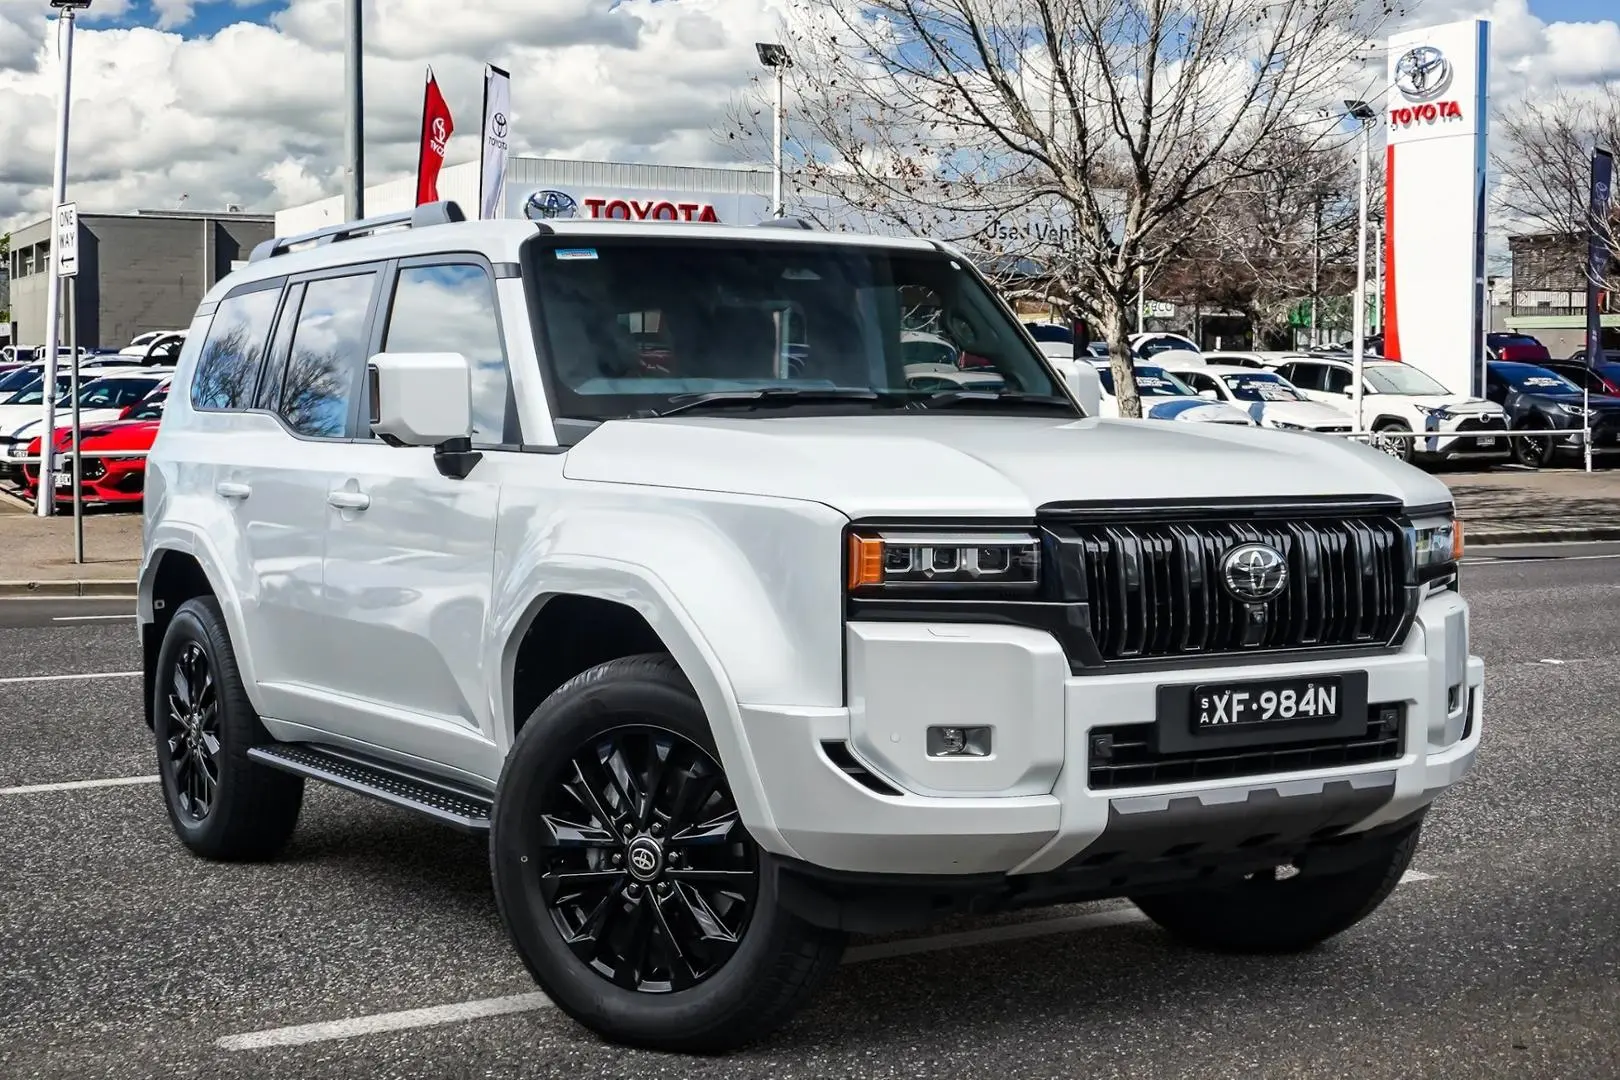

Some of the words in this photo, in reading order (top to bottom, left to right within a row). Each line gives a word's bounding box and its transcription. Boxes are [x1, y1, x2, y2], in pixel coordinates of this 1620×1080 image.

[1389, 101, 1462, 125] TOYOTA
[59, 209, 74, 228] ONE
[585, 199, 720, 222] TOYOTA
[59, 231, 75, 249] WAY
